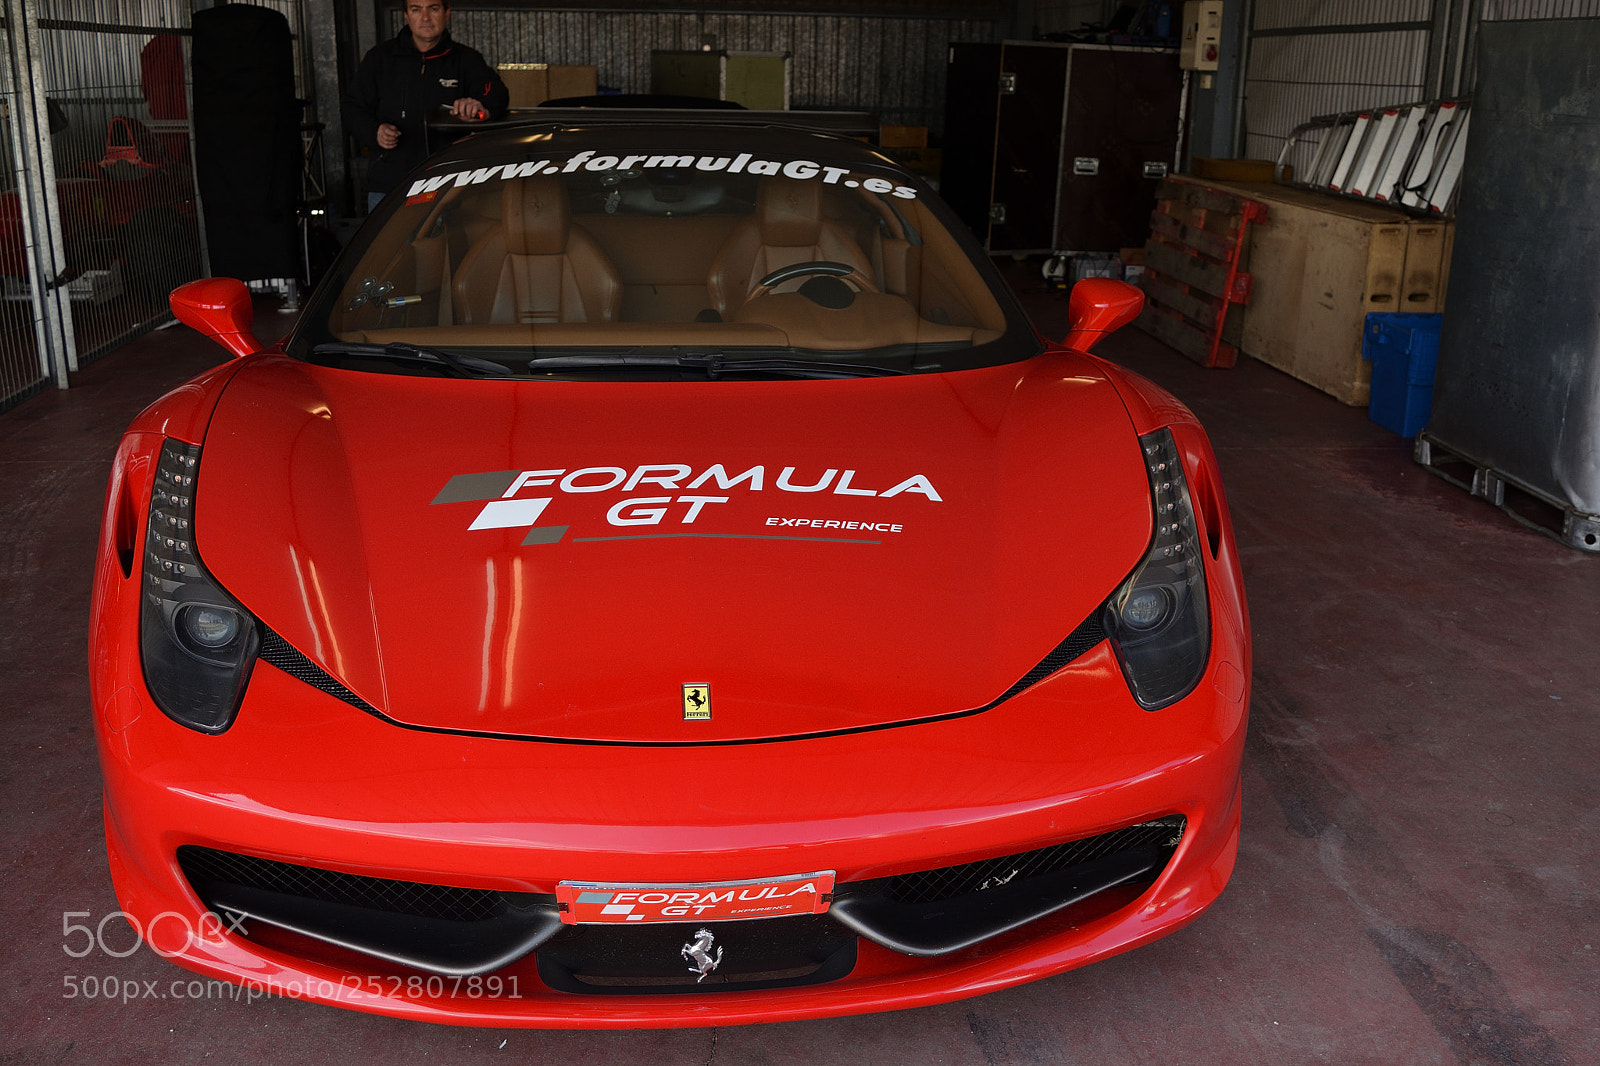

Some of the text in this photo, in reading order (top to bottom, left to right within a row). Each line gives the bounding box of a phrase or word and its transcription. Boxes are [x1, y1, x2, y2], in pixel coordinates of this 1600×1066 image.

[407, 150, 917, 199] www.formulaGT.es
[502, 464, 943, 502] FORMULA
[606, 496, 903, 533] GT EXPERIENCE
[612, 882, 816, 904] FORMULA
[662, 904, 792, 916] GT EXPERIENCE
